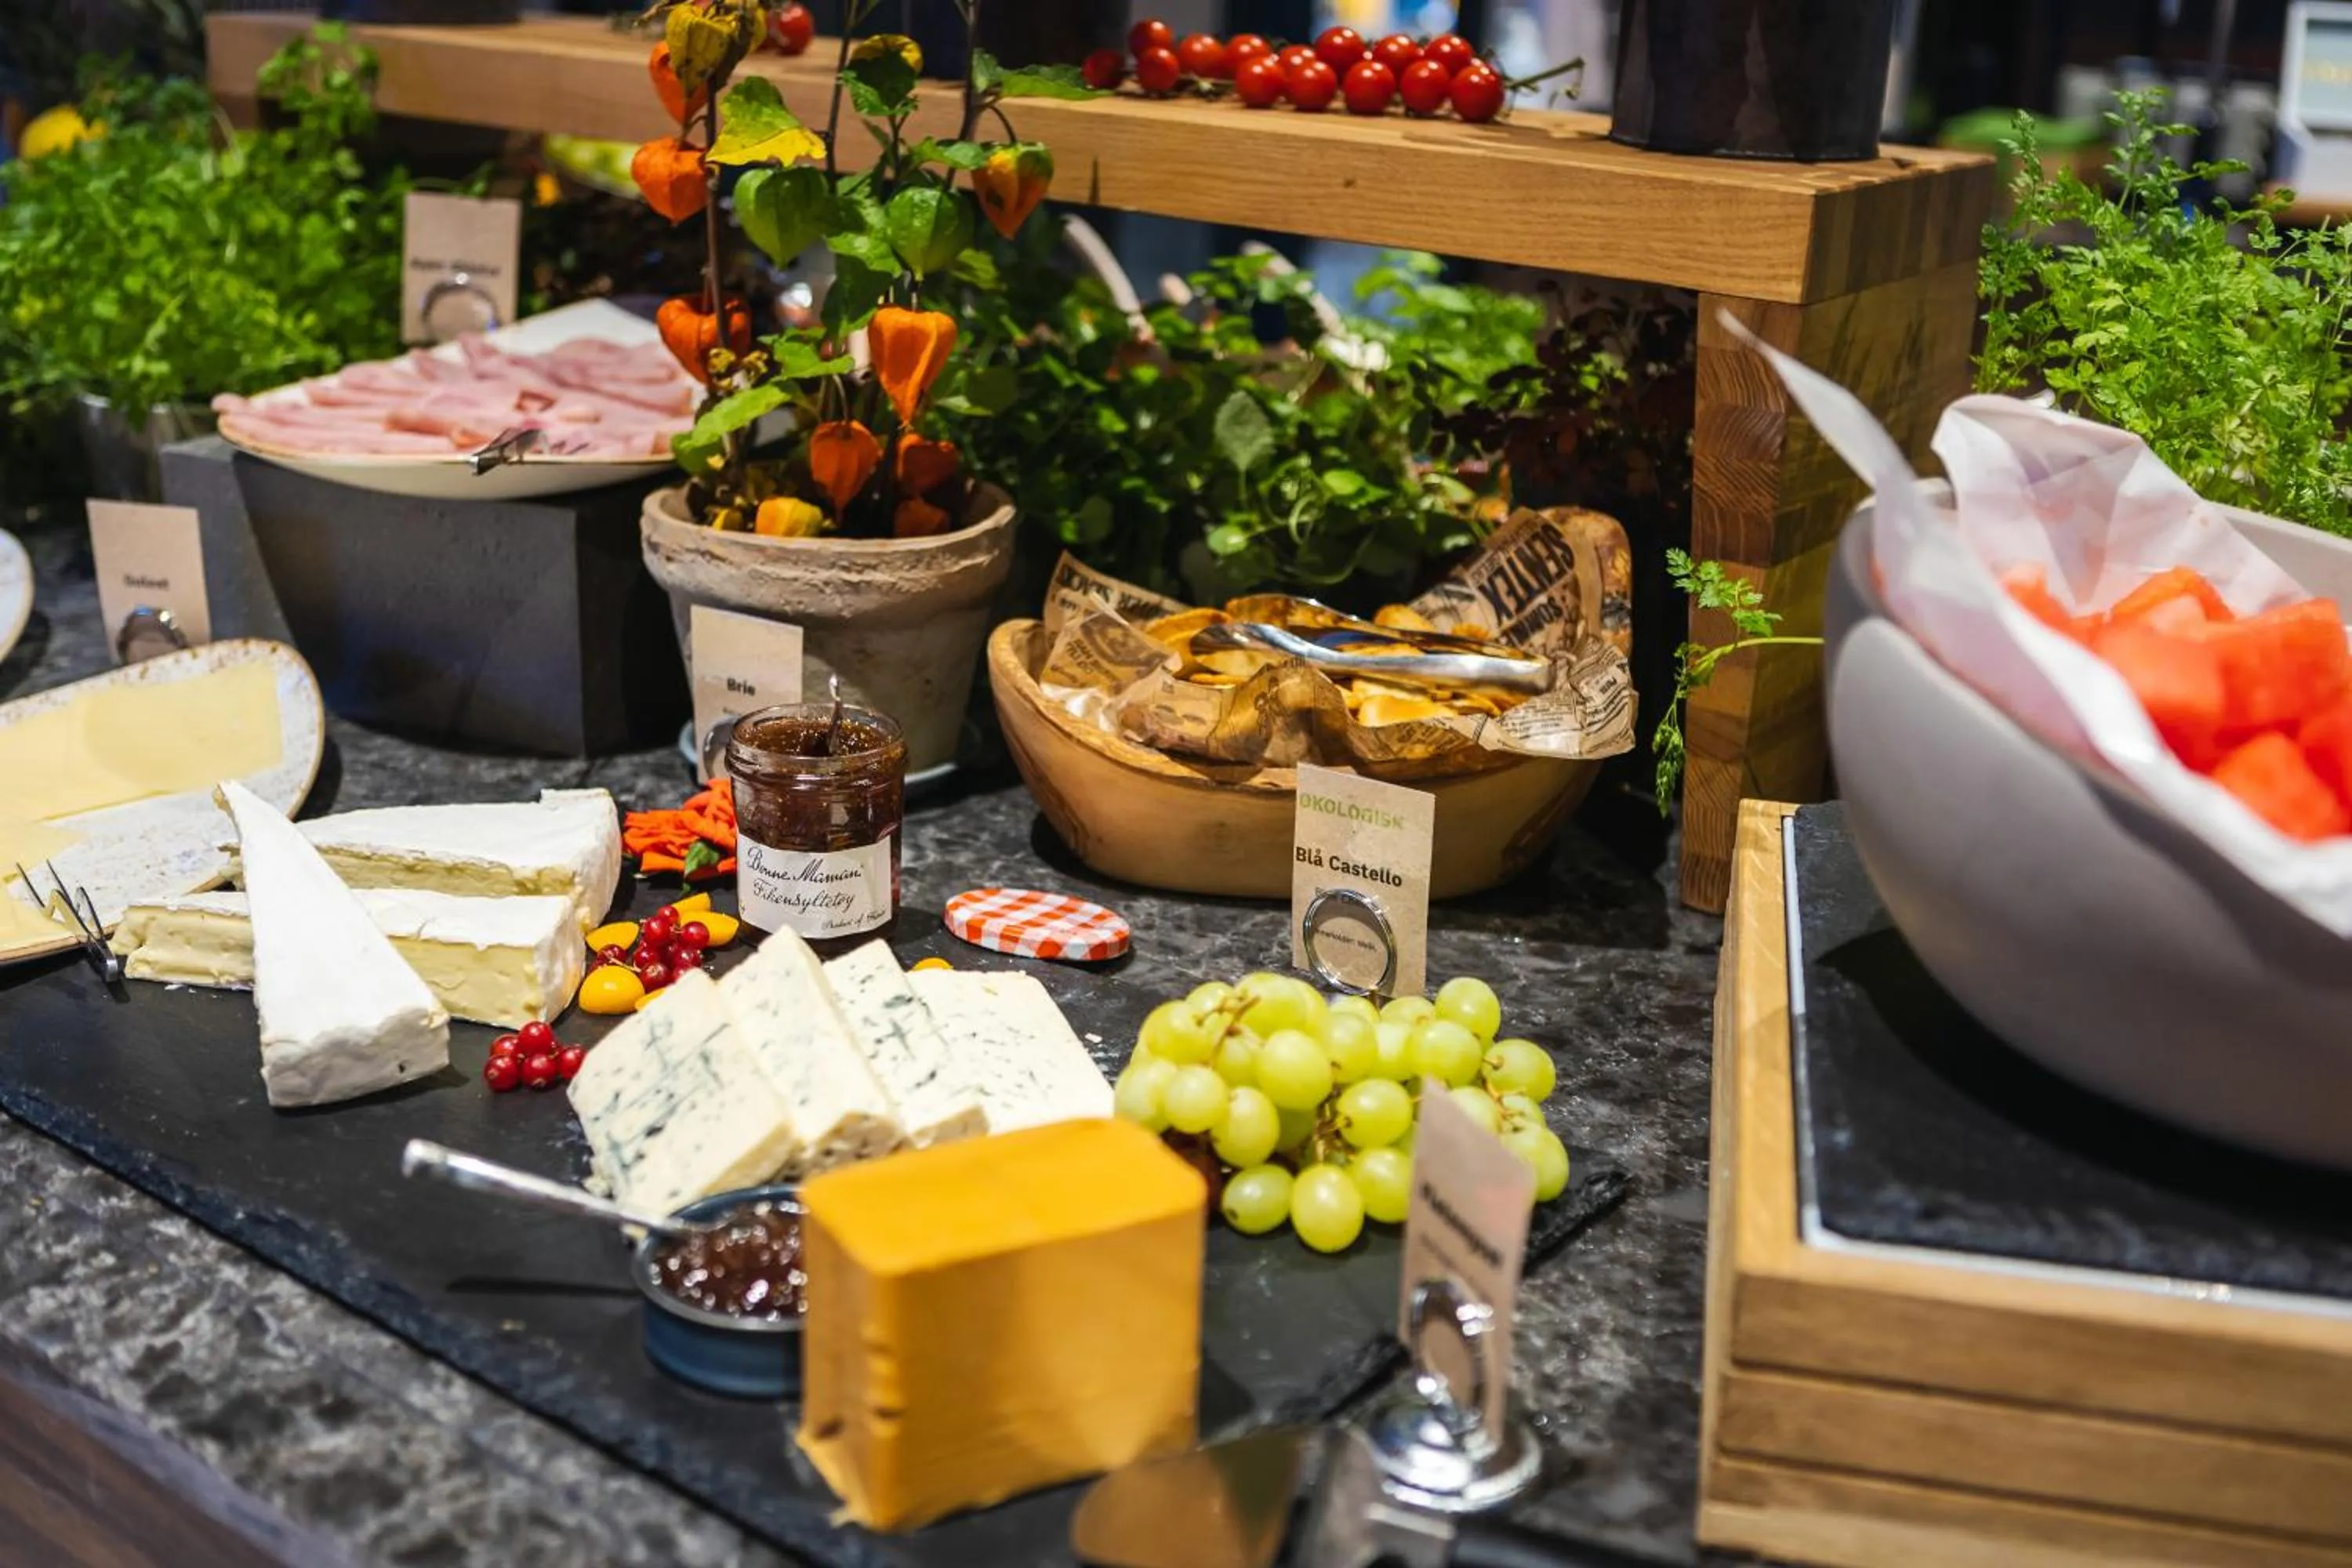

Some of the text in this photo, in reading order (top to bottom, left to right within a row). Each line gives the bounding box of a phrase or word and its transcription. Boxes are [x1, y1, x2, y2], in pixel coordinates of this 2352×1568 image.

[726, 677, 756, 697] Brie
[747, 846, 862, 883] Bonne Maman
[1295, 846, 1403, 887] Blå Castello
